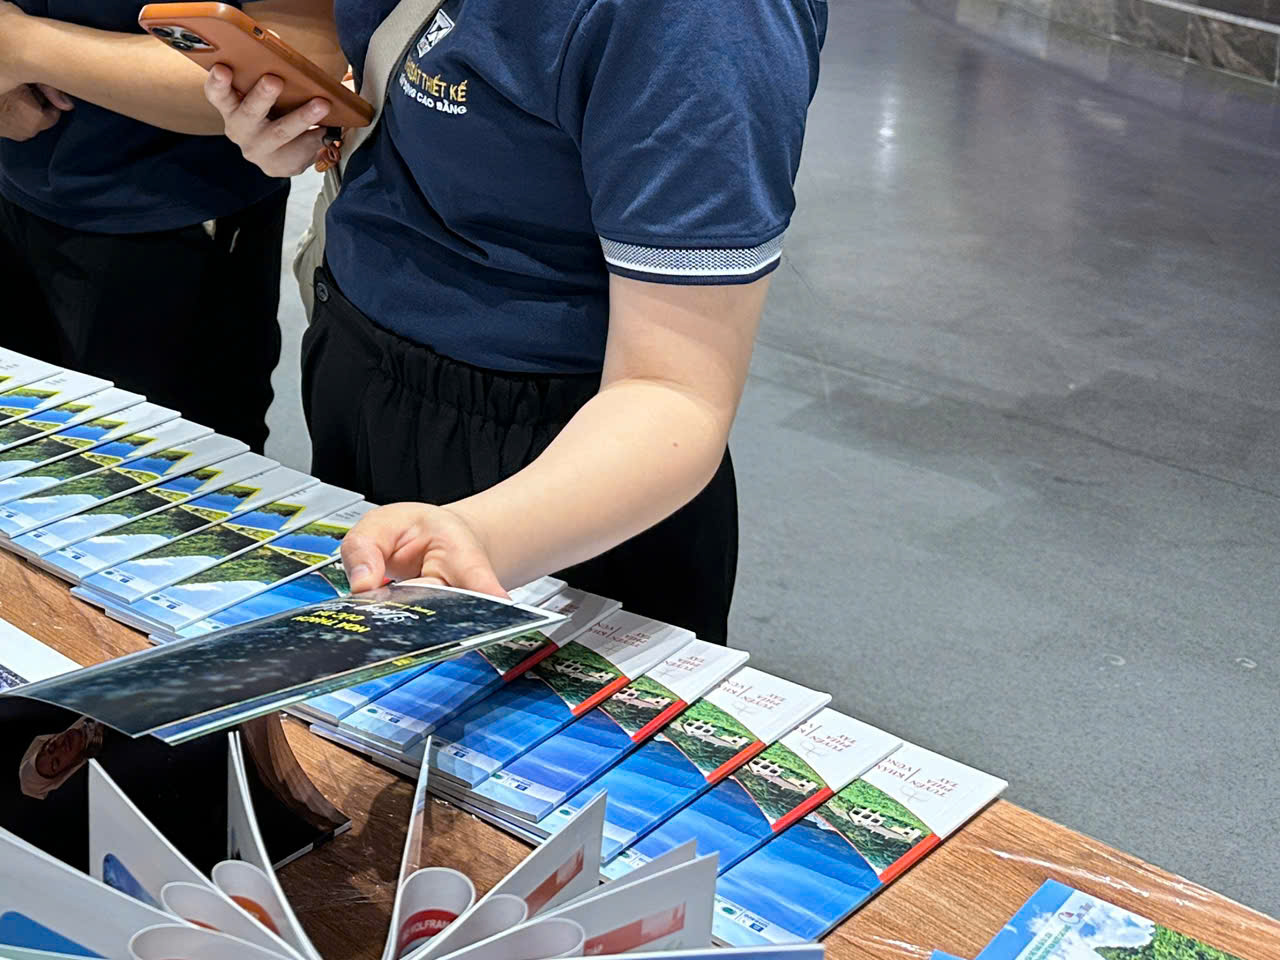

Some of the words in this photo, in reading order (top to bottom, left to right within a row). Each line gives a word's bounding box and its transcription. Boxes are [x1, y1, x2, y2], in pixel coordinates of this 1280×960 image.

[421, 73, 447, 98] THIẾT
[449, 80, 468, 102] KẾ
[417, 93, 435, 108] CAO
[436, 98, 467, 114] BẰNG
[923, 779, 954, 792] PHÍA
